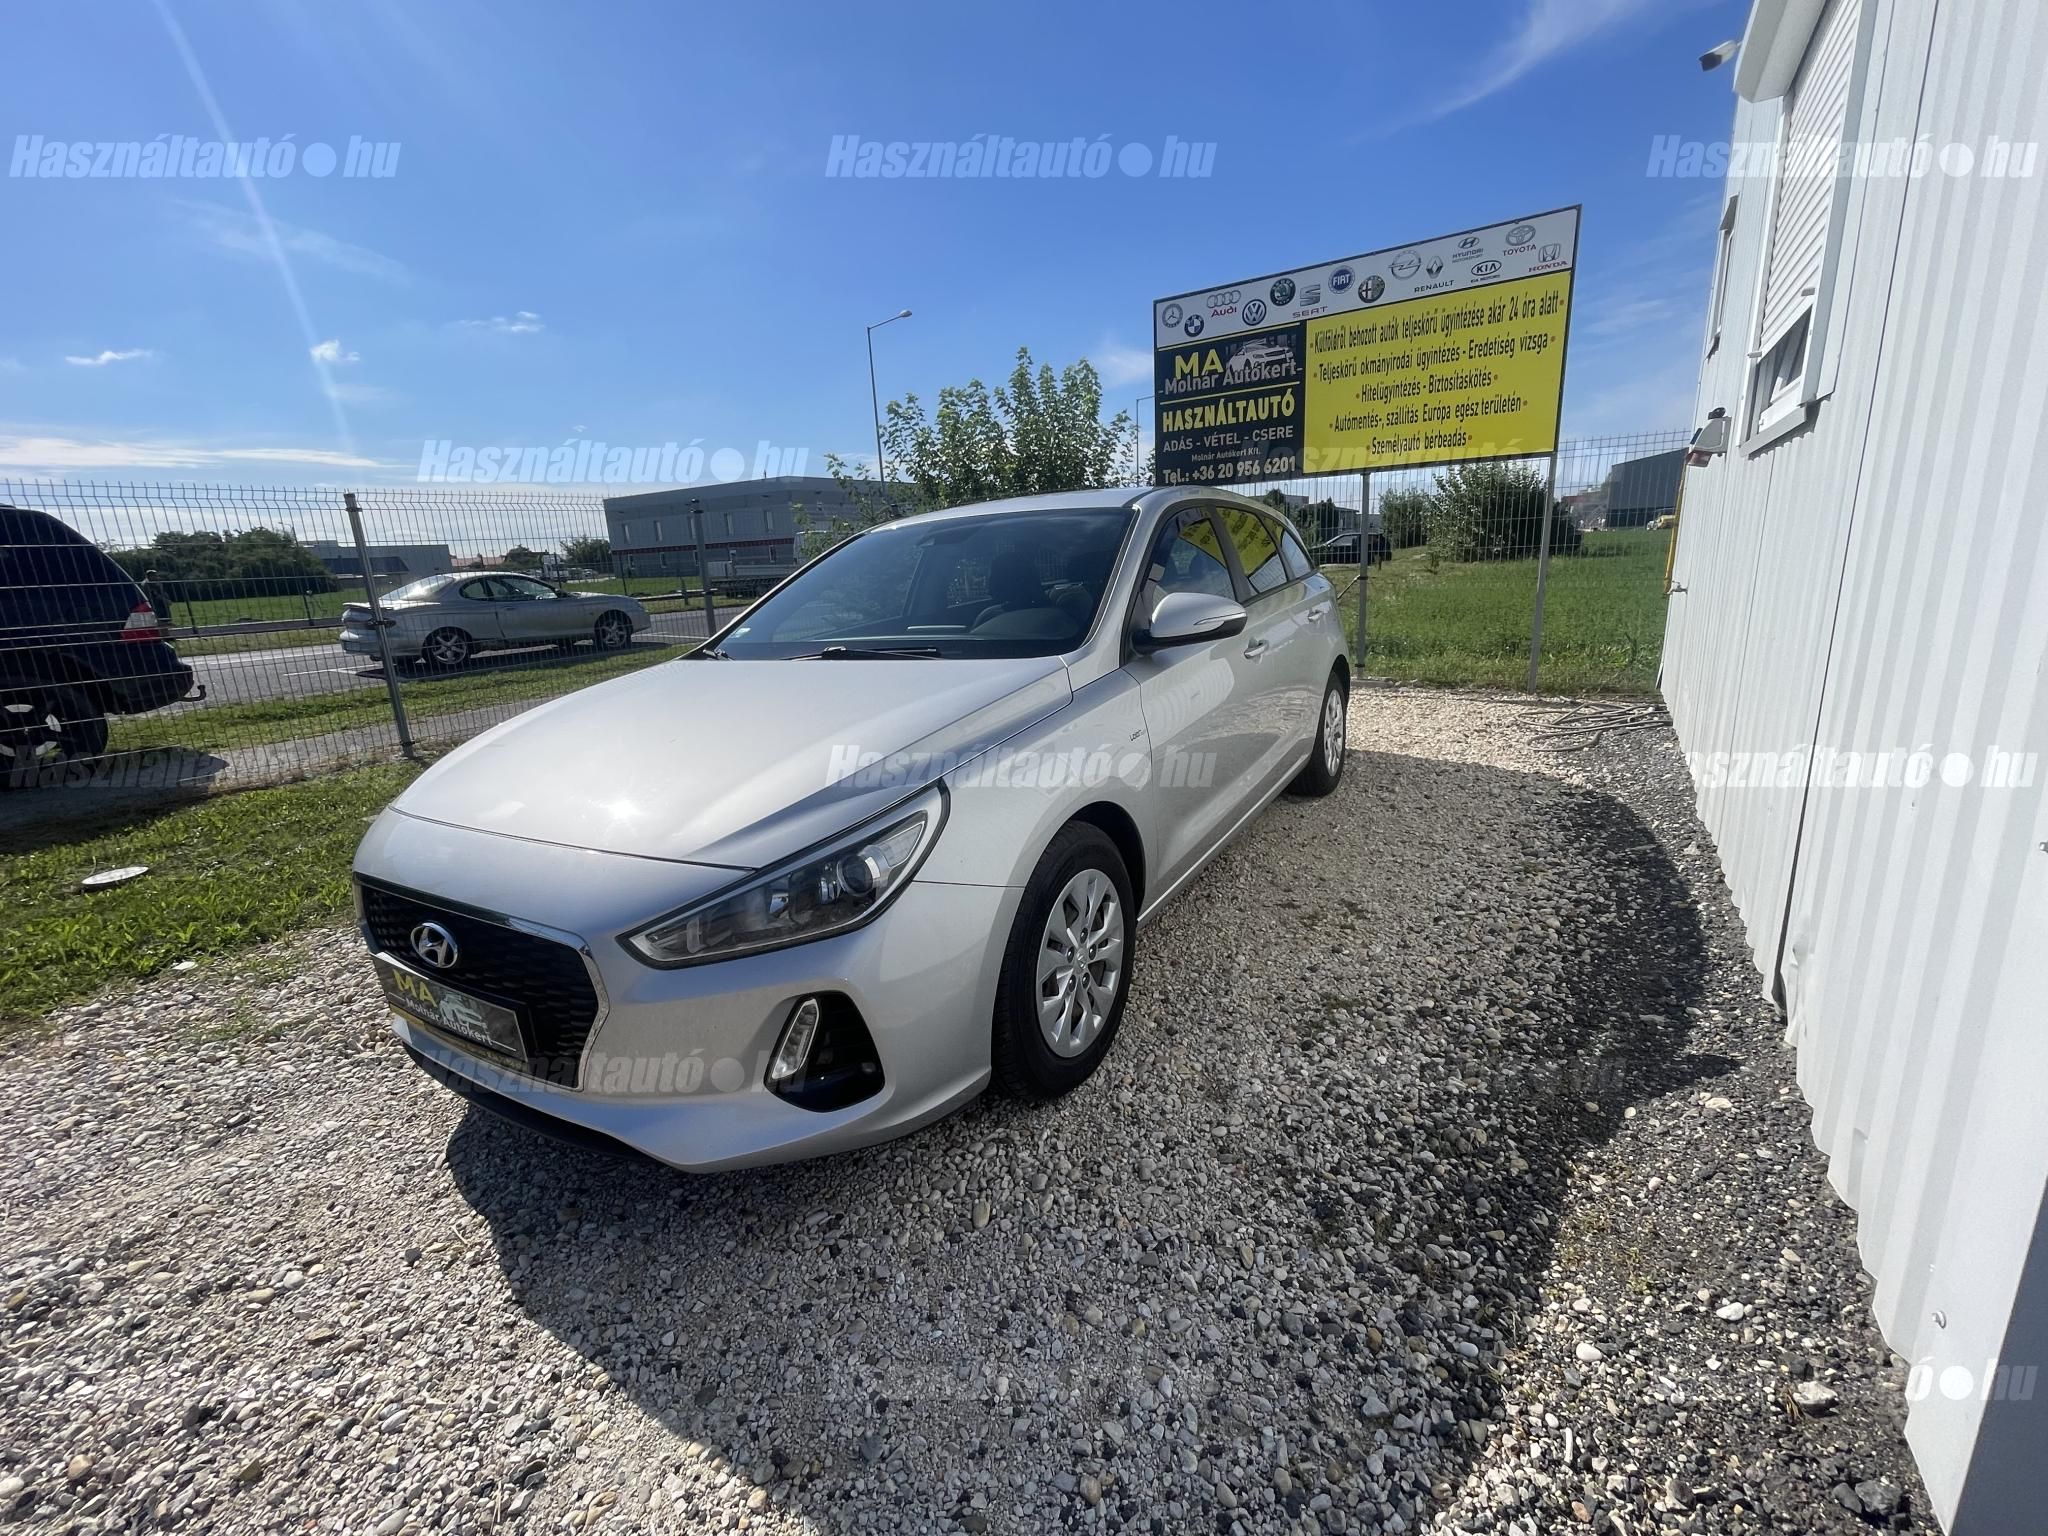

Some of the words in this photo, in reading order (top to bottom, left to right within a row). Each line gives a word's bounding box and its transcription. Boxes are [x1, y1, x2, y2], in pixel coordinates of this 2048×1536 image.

[1451, 247, 1484, 259] HYUNDAI
[1502, 244, 1537, 257] TOYOTA
[1528, 260, 1568, 273] HONDA
[1332, 273, 1351, 286] FIAT
[1413, 280, 1455, 293] RENAULT
[1211, 307, 1237, 318] Audi
[1292, 306, 1328, 319] SEAT
[1314, 325, 1346, 353] Külföldről
[1349, 322, 1377, 348] behozott
[1379, 315, 1399, 342] autók
[1402, 308, 1438, 343] teljeskörű
[1440, 301, 1485, 337] ügyintézése
[1488, 296, 1506, 324] akár
[1509, 295, 1519, 321] 24
[1522, 291, 1535, 318] óra
[1539, 290, 1559, 315] alatt
[1175, 349, 1224, 380] MA
[1319, 356, 1357, 384] Teljeskörű
[1360, 350, 1413, 377] okmányirodai
[1416, 340, 1460, 371] ügyintézés
[1468, 332, 1515, 360] Eredetiség
[1520, 330, 1548, 355] vizsga
[1164, 370, 1219, 395] Molnár
[1361, 376, 1421, 405] Hitelügyintézés
[1428, 366, 1492, 394] Biztosításkötés
[1162, 388, 1295, 433] HASZNÁLTAUTÓ
[1386, 402, 1419, 427] szállítás
[1423, 398, 1451, 424] Európa
[1455, 396, 1479, 423] egész
[1481, 391, 1521, 414] területén
[1163, 437, 1193, 453] ADÁS
[1203, 432, 1241, 447] VÉTEL
[1252, 425, 1294, 442] CSERE
[1371, 429, 1421, 456] Személyautó
[1424, 423, 1467, 449] bérbeadás
[1191, 453, 1215, 462] Molnár
[1192, 464, 1215, 481] +36
[1218, 462, 1234, 478] 20
[1236, 459, 1260, 477] 956
[1263, 456, 1296, 474] 6201
[392, 968, 438, 1008] MA
